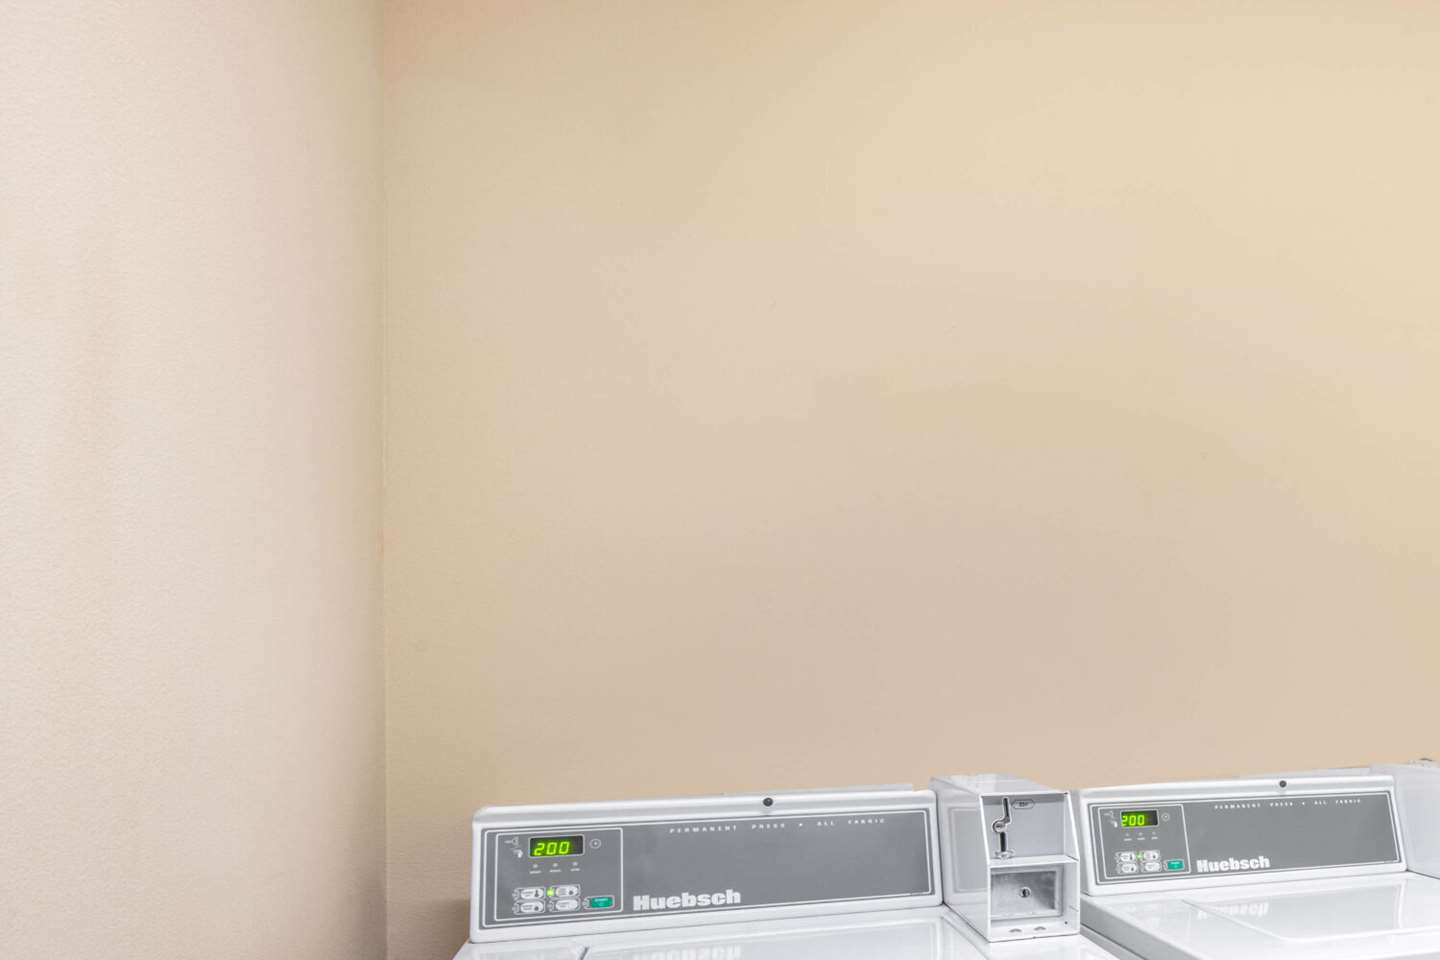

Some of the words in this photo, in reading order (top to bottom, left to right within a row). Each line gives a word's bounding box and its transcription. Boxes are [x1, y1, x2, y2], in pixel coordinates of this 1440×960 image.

[1121, 814, 1146, 827] 200
[669, 823, 737, 834] PERMANENT
[533, 841, 571, 856] 200
[1196, 855, 1271, 873] Huebsch
[632, 888, 742, 911] Huebsch
